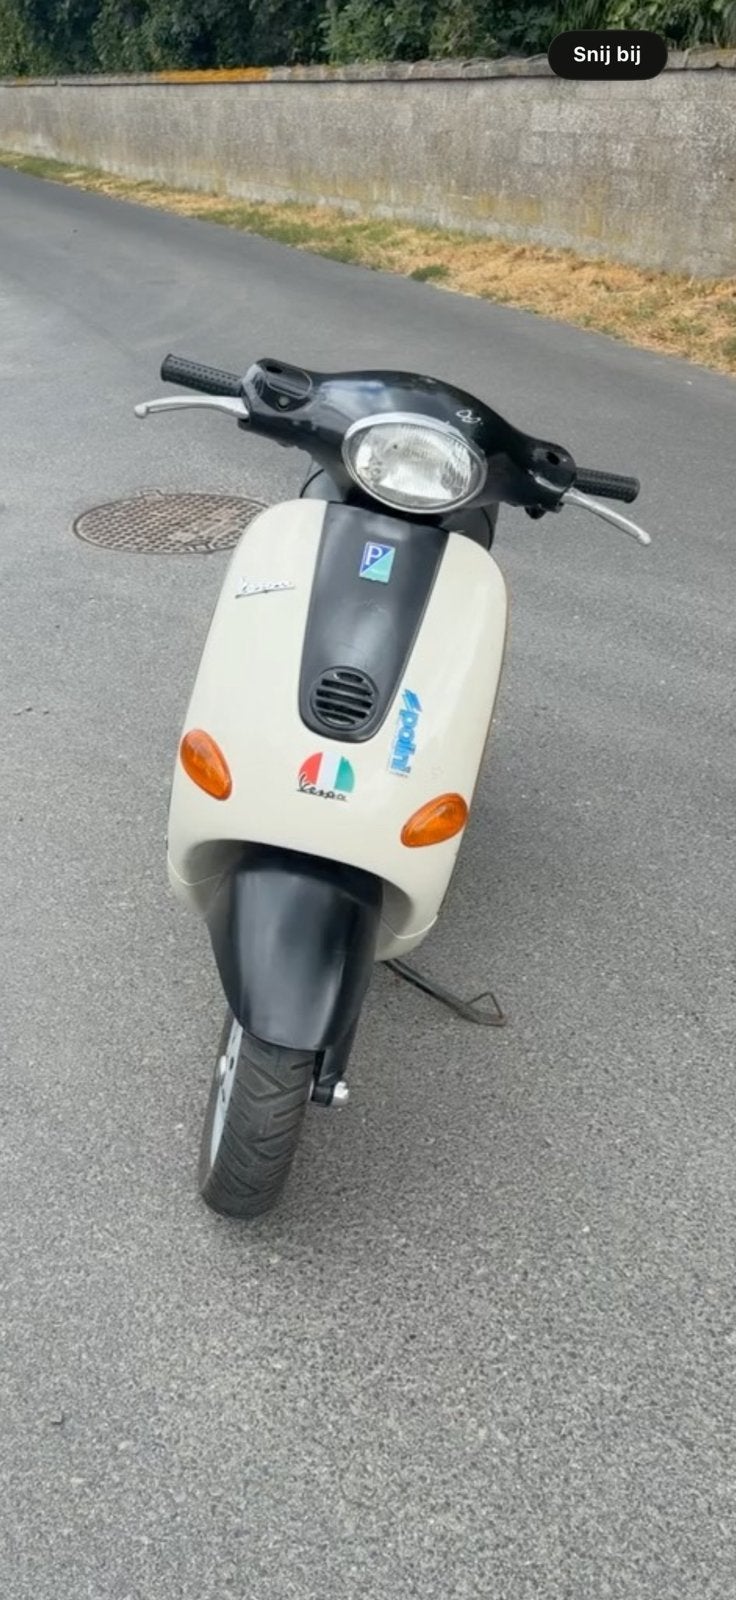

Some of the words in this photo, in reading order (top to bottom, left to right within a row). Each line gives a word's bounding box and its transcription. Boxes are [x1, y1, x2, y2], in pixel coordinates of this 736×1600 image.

[365, 545, 383, 566] P
[391, 709, 419, 774] polini
[296, 773, 348, 802] Vespa
